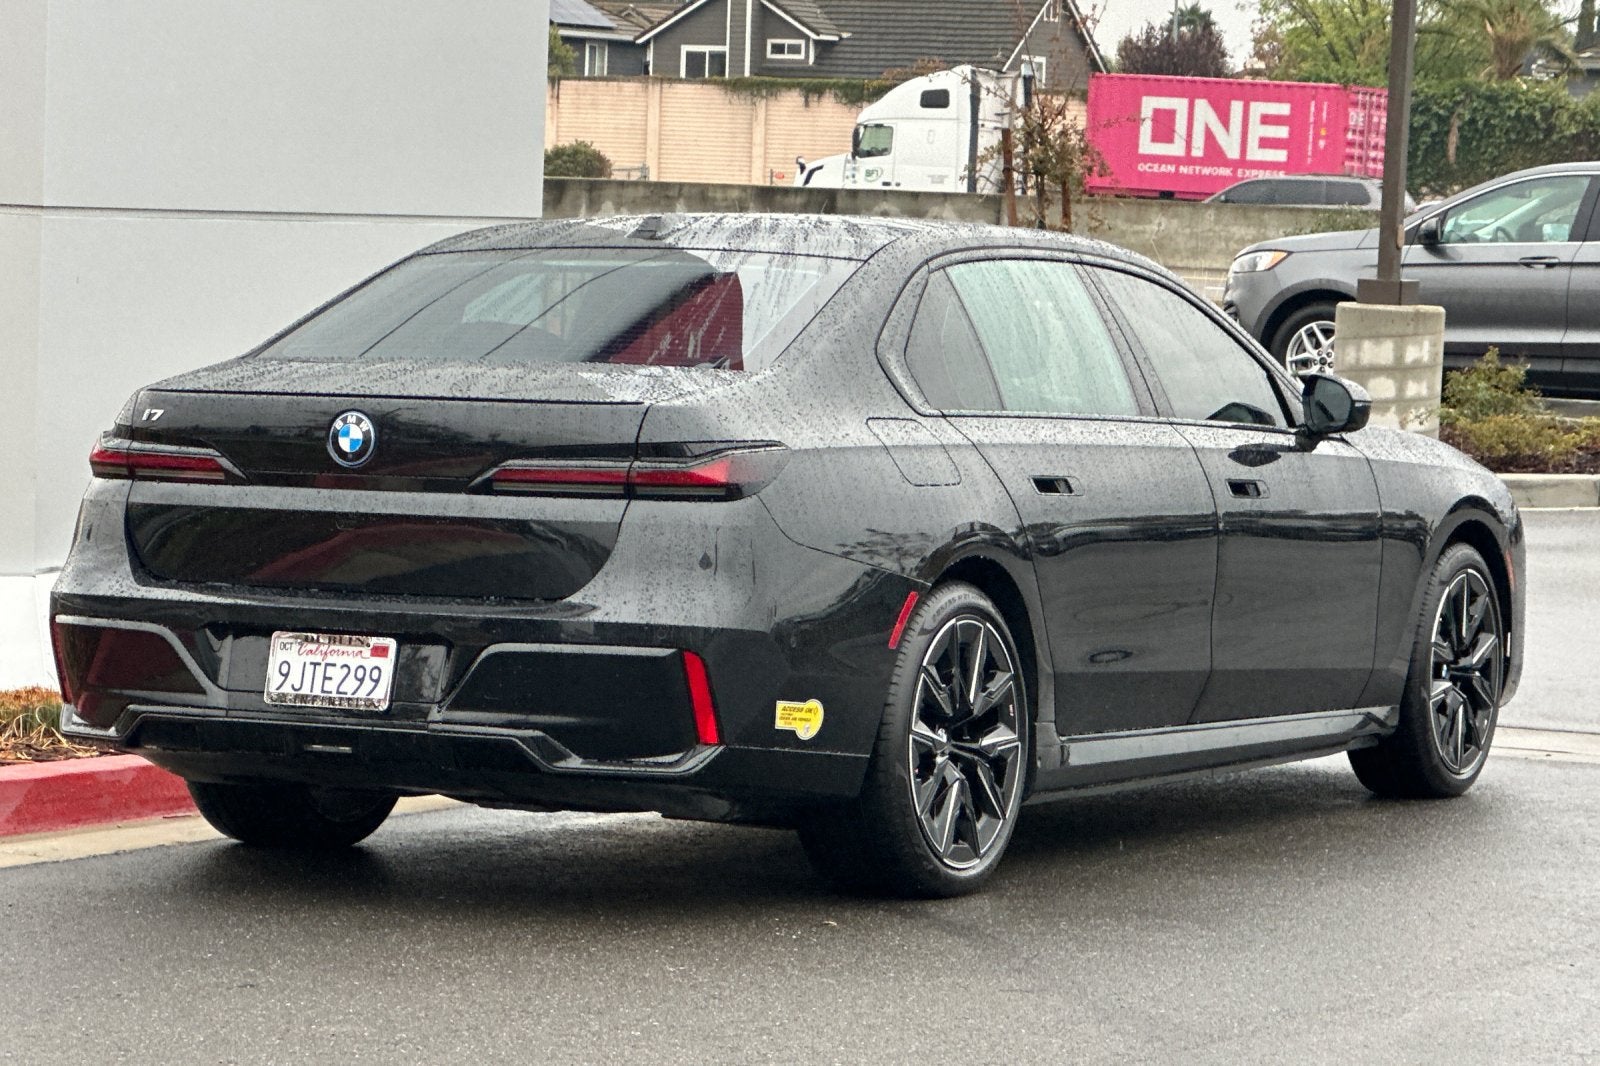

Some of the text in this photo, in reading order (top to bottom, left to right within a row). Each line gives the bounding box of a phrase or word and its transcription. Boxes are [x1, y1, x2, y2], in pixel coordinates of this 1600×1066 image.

[1138, 95, 1291, 162] ONE
[1137, 162, 1286, 178] OCEAN NETWORK EXPRESS
[334, 414, 370, 432] BMW
[280, 641, 293, 651] OCT
[297, 642, 369, 662] California
[275, 660, 382, 696] 9JTE299
